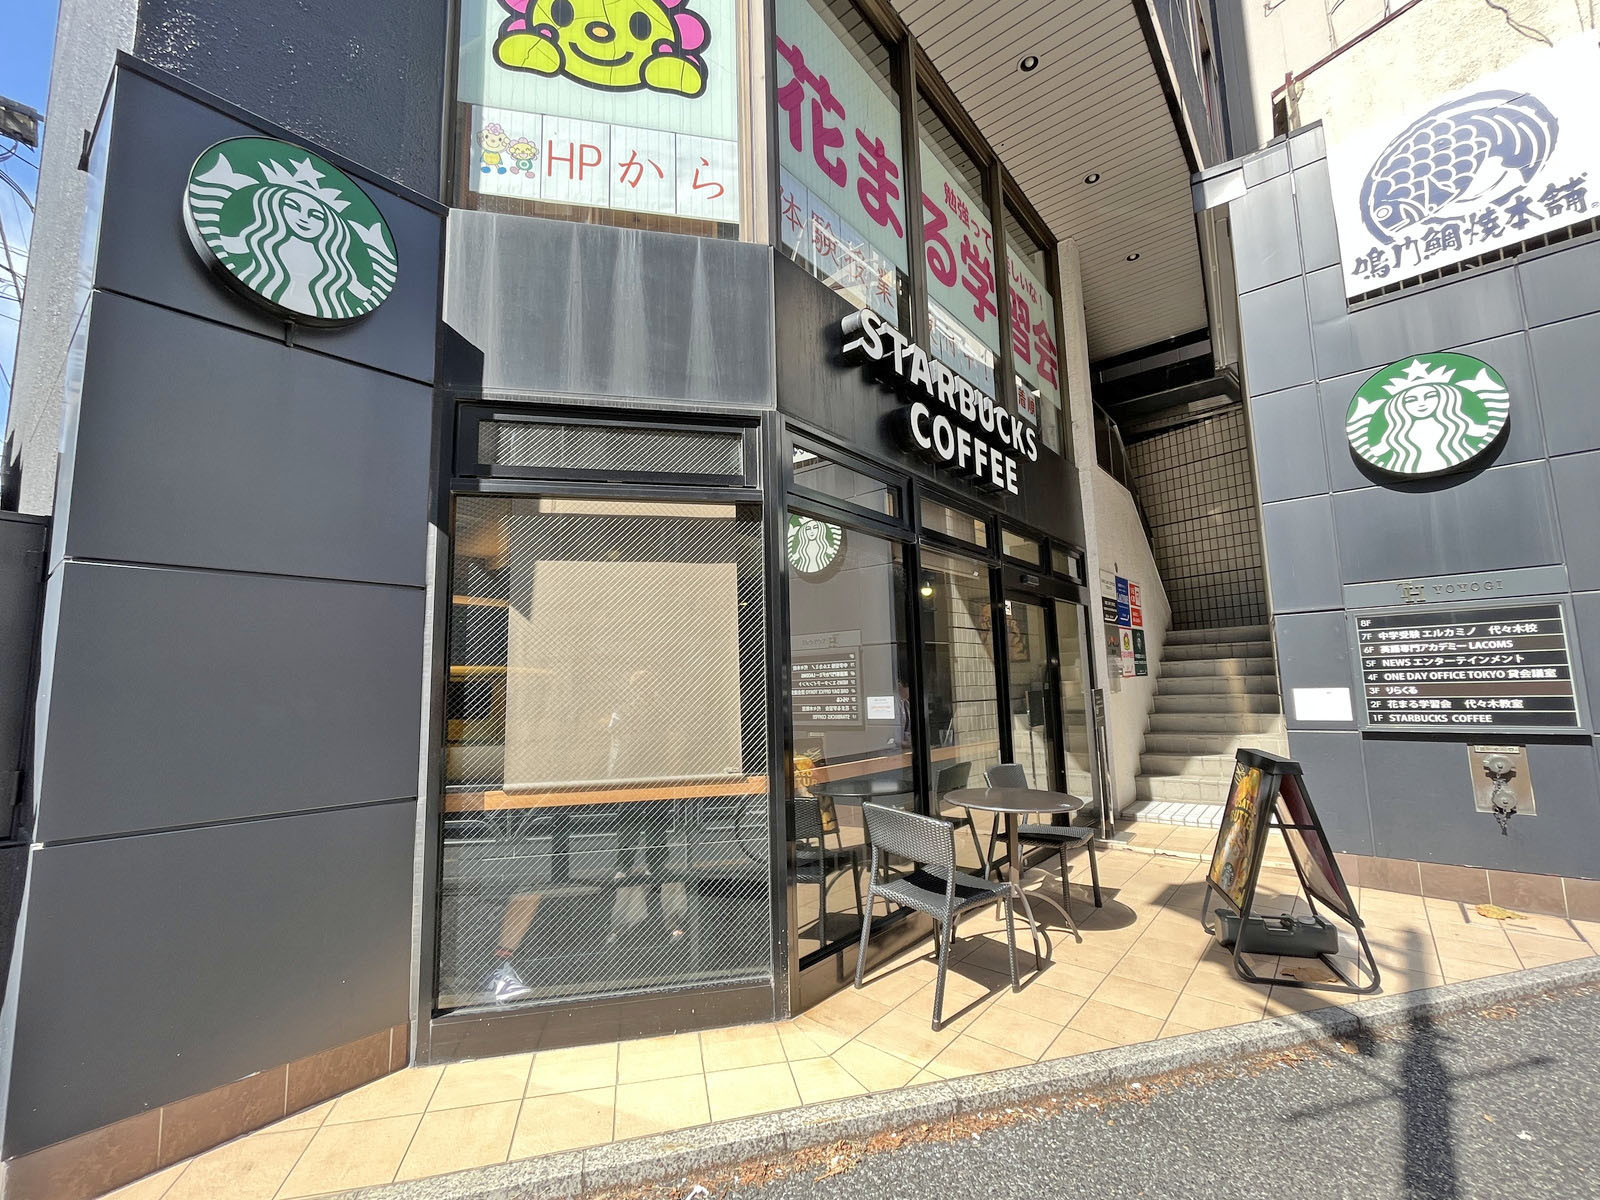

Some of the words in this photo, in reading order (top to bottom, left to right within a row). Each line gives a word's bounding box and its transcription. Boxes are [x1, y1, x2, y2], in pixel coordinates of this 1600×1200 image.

[1351, 171, 1589, 280] 鳴門鯛焼本舗
[841, 307, 1039, 463] STARBUCKS
[910, 402, 1019, 496] COFFEE
[1432, 580, 1504, 595] YOYOGI
[1360, 619, 1372, 628] 8F
[1361, 632, 1373, 641] 7F
[1422, 625, 1477, 638] エルカミノ
[1488, 622, 1539, 635] 代々木校
[1363, 646, 1375, 654] 6F
[1468, 639, 1514, 650] LACOMS
[1365, 659, 1377, 668] 5F
[1382, 658, 1412, 667] NEWS
[1413, 653, 1525, 666] エンターテインメント
[1367, 673, 1379, 682] 4F
[1383, 672, 1406, 681] ONE
[1406, 671, 1428, 681] DAY
[1429, 670, 1467, 680] OFFICE
[1467, 669, 1506, 680] TOKYO
[1368, 686, 1381, 695] 3F
[1385, 685, 1419, 695] りらくる
[1370, 700, 1383, 709] 2F
[1387, 699, 1453, 710] 花まる学習会
[1372, 714, 1384, 723] 1F
[1388, 714, 1449, 723] STARBUCKS
[1451, 714, 1493, 723] COFFEE
